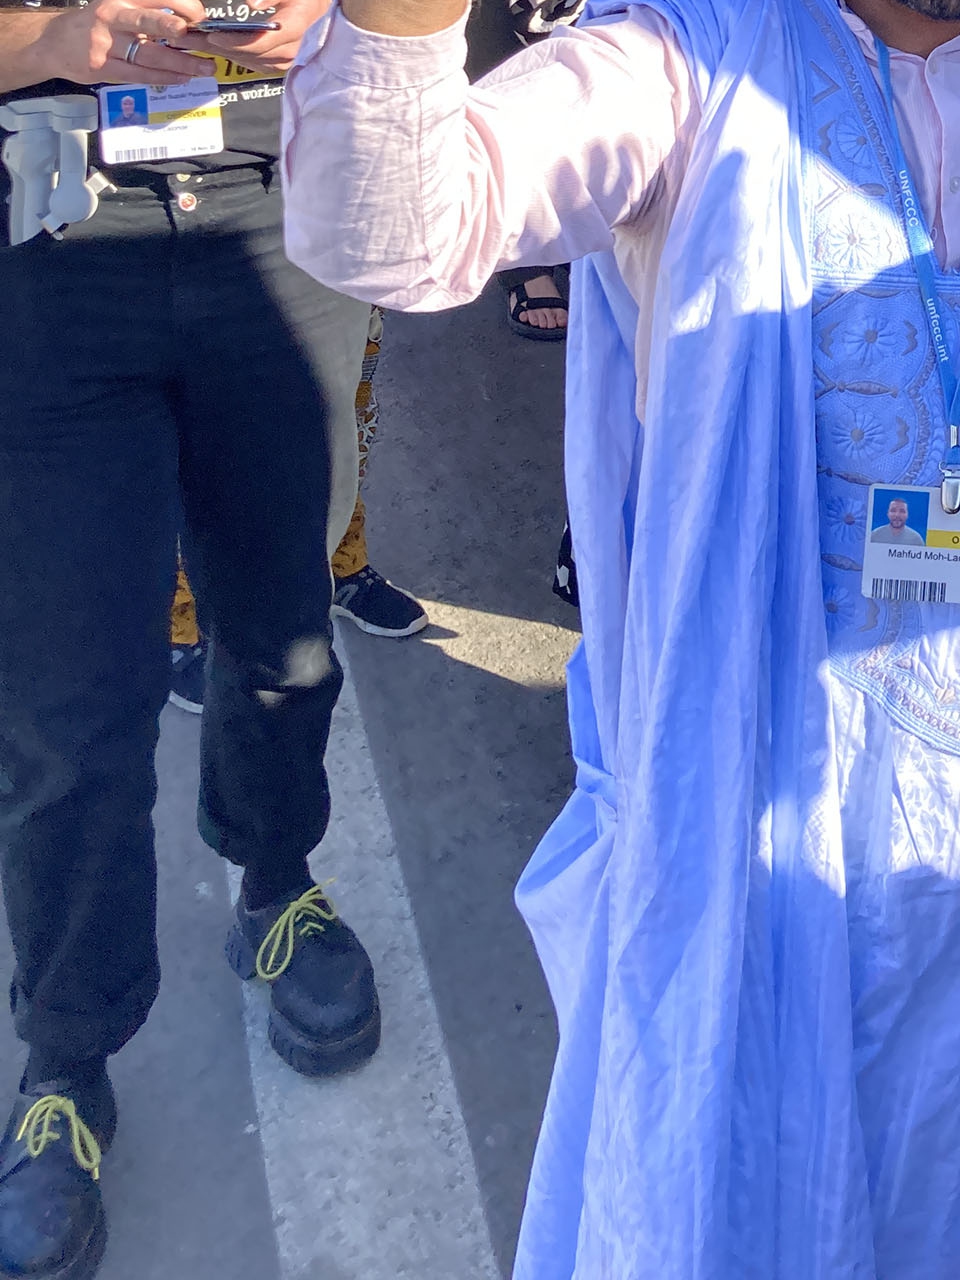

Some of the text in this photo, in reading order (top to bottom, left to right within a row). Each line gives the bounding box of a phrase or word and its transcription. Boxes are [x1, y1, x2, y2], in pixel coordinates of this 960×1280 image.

[899, 170, 919, 227] UNFCCC
[926, 298, 950, 363] unfccc.int
[888, 549, 922, 560] Mahfud
